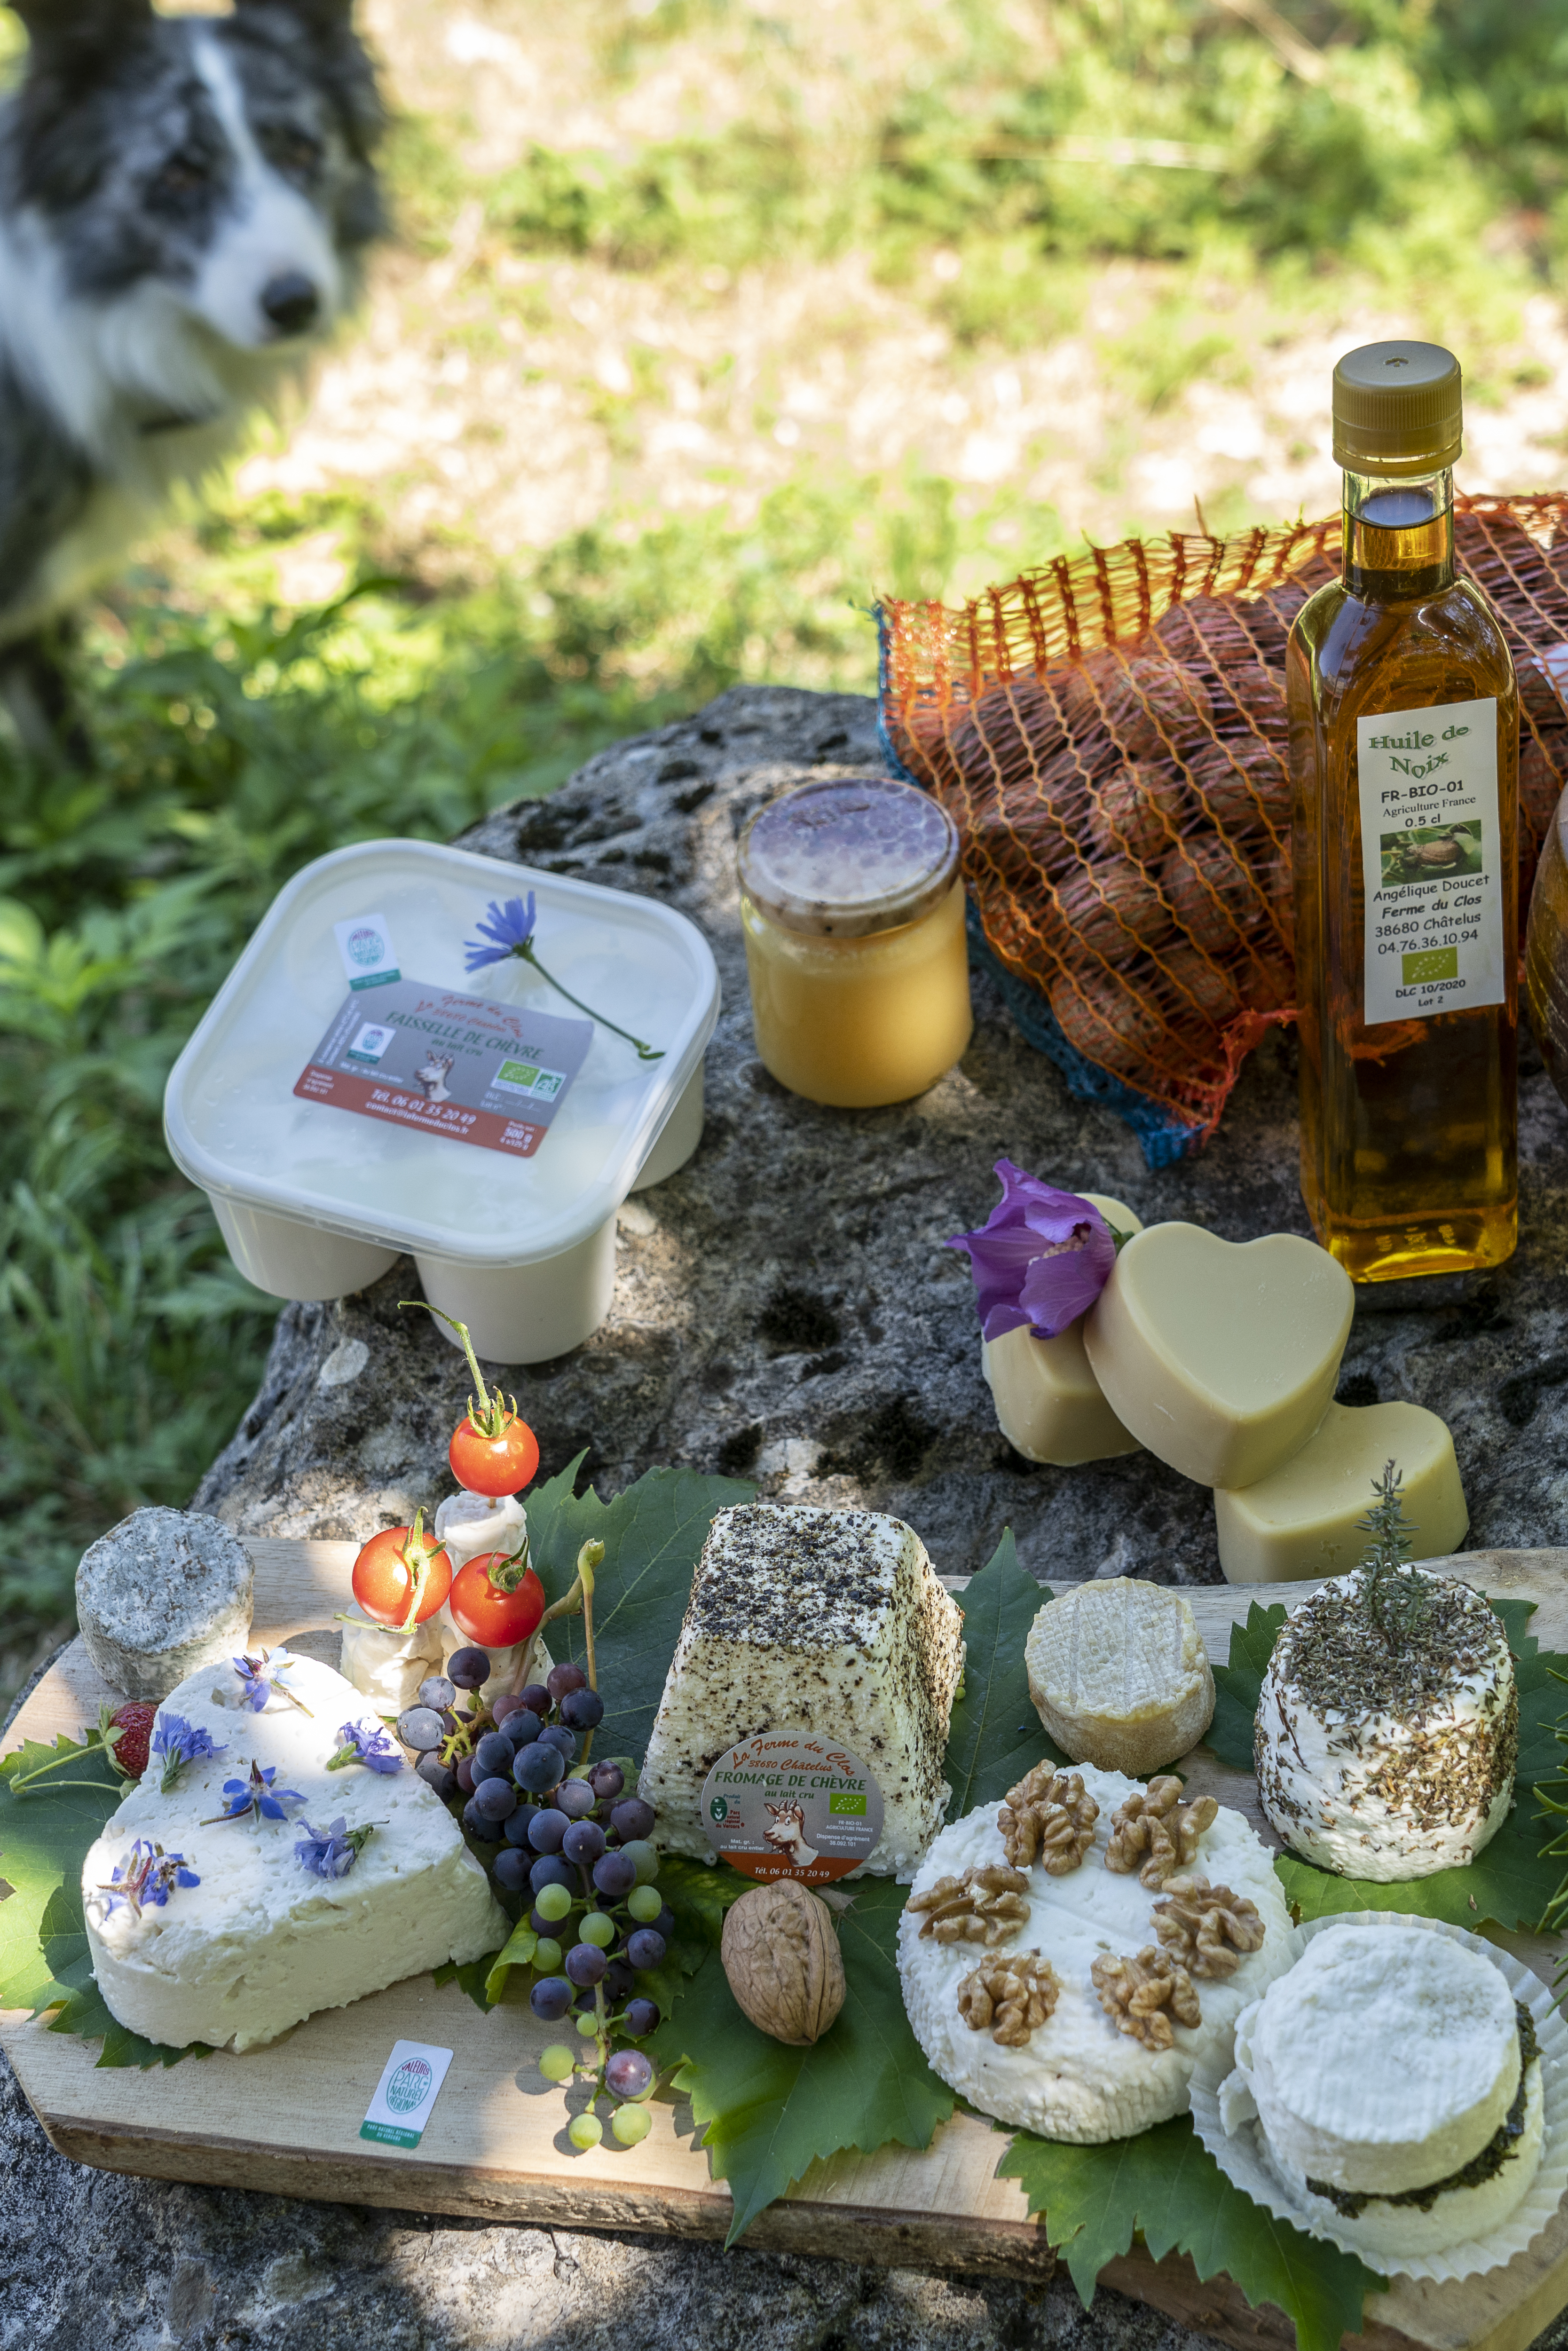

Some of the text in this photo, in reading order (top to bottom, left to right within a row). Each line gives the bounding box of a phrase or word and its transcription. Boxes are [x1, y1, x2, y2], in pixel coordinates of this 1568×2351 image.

[1368, 725, 1469, 749] Huile de
[1388, 752, 1449, 779] Noix
[1381, 780, 1464, 804] FR-BIO-01
[1382, 797, 1476, 818] Agriculture France
[1404, 813, 1441, 828] 0.5 cl
[1373, 875, 1490, 903] Angélique Doucet
[1381, 894, 1482, 919] Ferme du Clos
[1375, 913, 1481, 938] 38680 Châtelus
[1378, 929, 1478, 955] 04.76.36.10.94
[1395, 979, 1466, 998] DLC 10/2020
[1418, 998, 1434, 1007] Lot
[385, 1011, 465, 1039] FAISSELLE
[463, 1030, 486, 1045] DE
[485, 1036, 545, 1060] CHÈVRE
[371, 1088, 477, 1125] Tél. 06 01 35 20 49
[504, 1126, 525, 1140] 500
[733, 1738, 855, 1776] La Ferme du Clos
[748, 1759, 833, 1772] 38680 Châtelus
[714, 1771, 867, 1791] FROMAGE DE CHÈVRE
[780, 1790, 796, 1798] lait
[402, 2060, 430, 2075] VALEURS
[394, 2070, 429, 2090] PARC
[390, 2085, 423, 2100] NATUREL
[389, 2095, 417, 2111] RÉGIONAL
